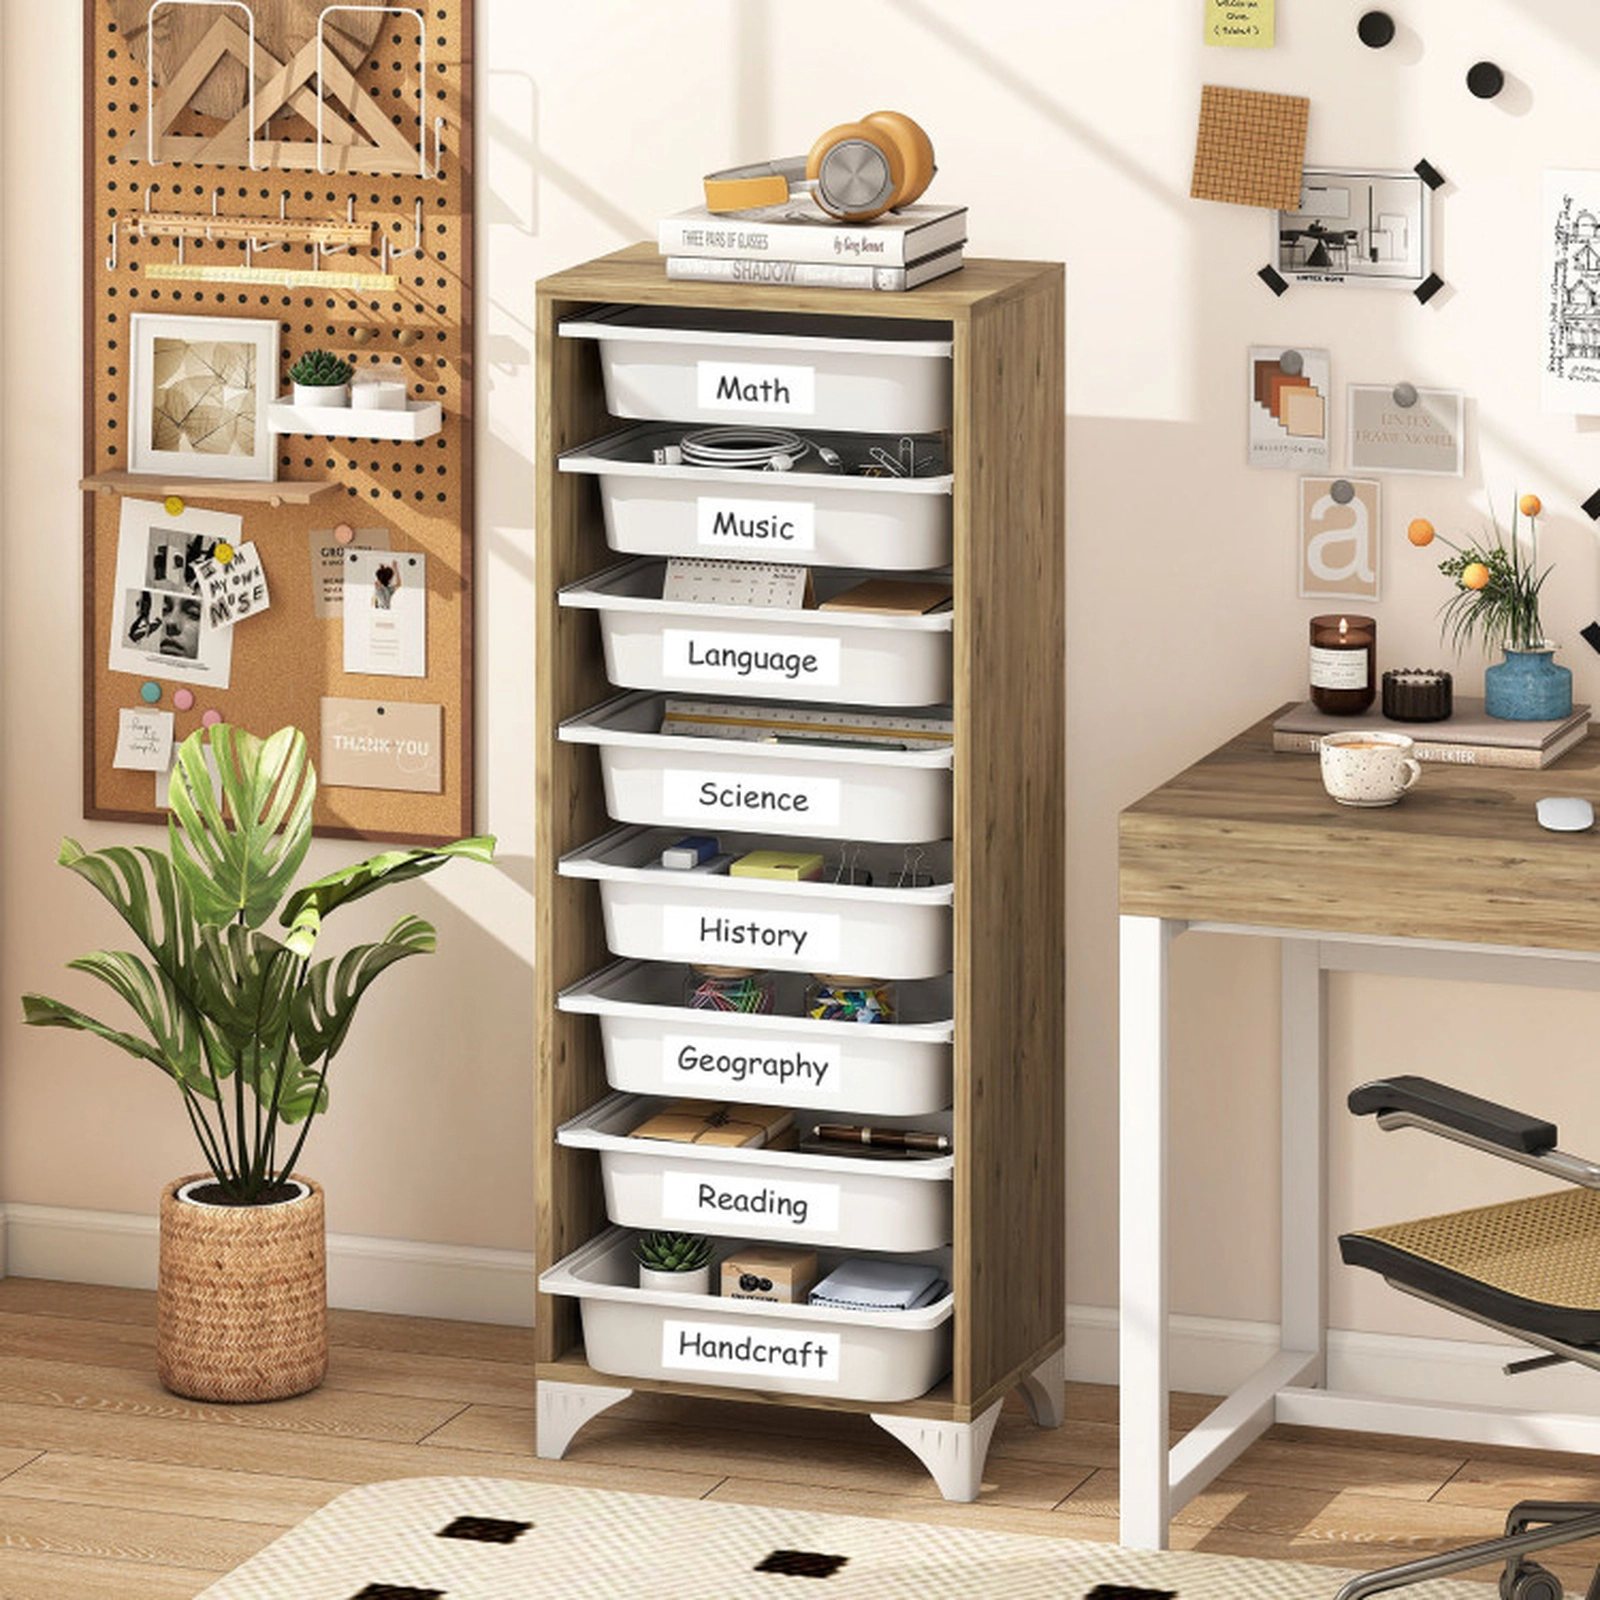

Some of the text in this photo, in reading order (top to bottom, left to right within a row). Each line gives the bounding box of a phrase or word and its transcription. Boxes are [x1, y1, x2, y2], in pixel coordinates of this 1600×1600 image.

[682, 229, 704, 246] THREE
[738, 232, 769, 250] GLASSES
[732, 260, 797, 282] SHADOW
[717, 376, 790, 404] Math
[713, 511, 794, 540] Music
[210, 565, 261, 598] MY OWN
[210, 585, 264, 628] MUSE
[689, 641, 818, 679] Language
[331, 734, 430, 757] THANK YOU
[699, 782, 809, 812] Science
[700, 917, 808, 955] History
[678, 1045, 829, 1086] Geography
[699, 1183, 808, 1224] Reading
[679, 1331, 827, 1368] Handcraft
